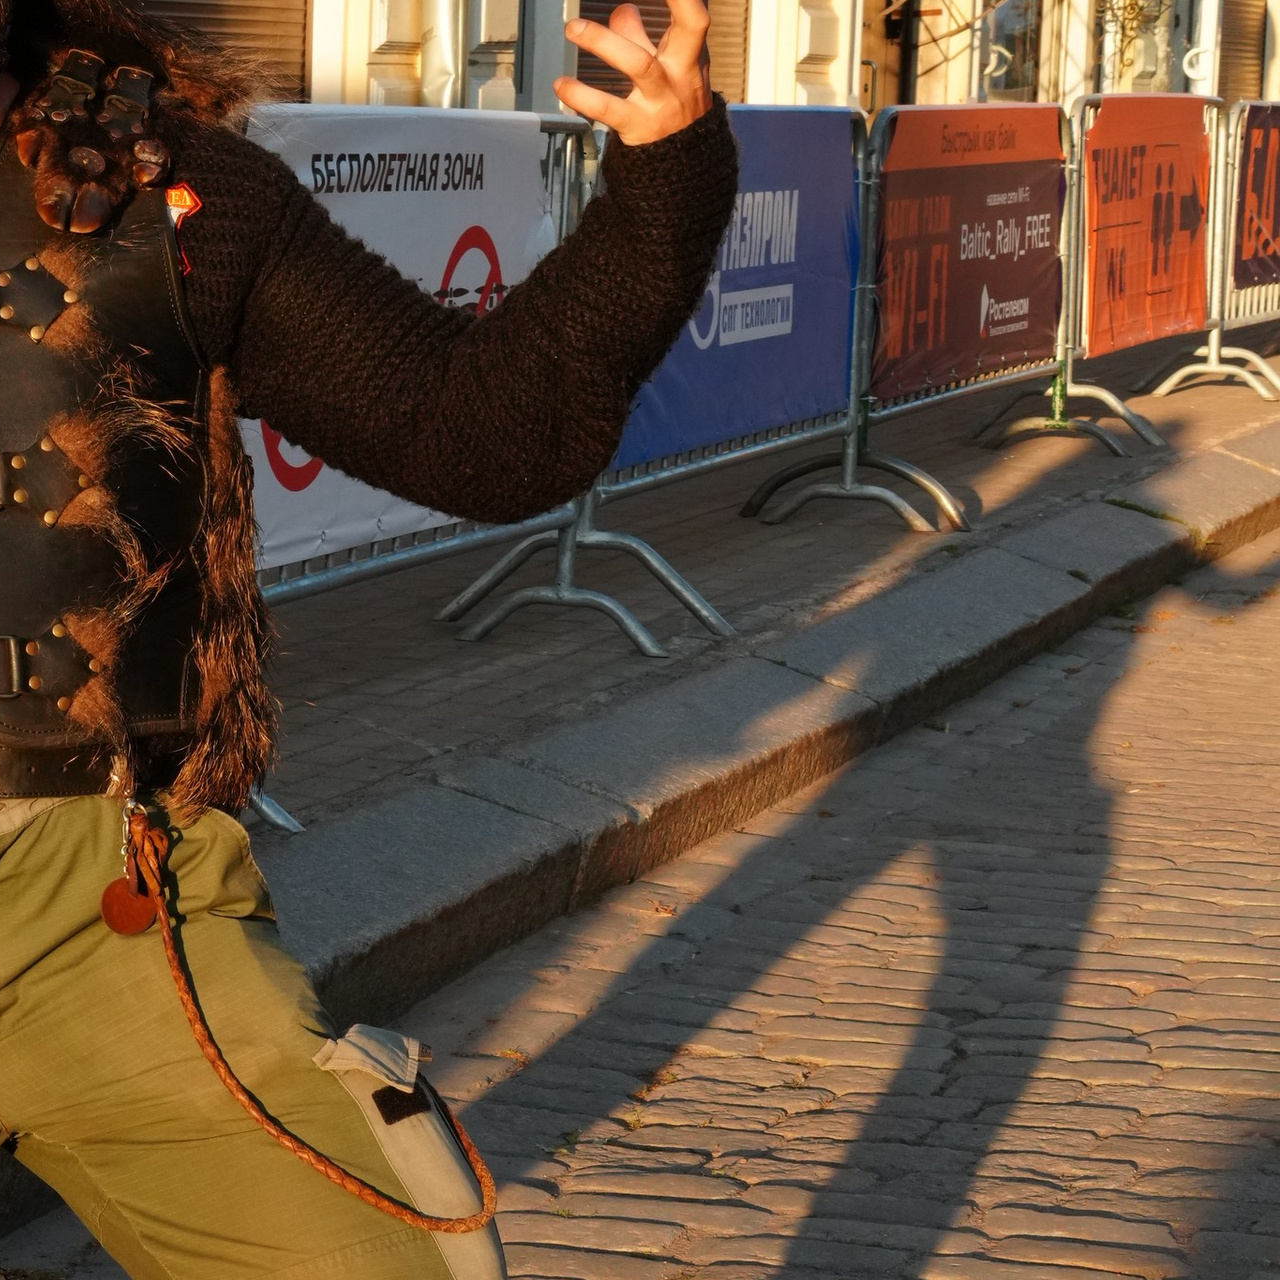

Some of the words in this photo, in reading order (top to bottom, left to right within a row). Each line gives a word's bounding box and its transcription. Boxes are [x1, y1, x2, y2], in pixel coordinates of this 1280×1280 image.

[311, 153, 440, 193] БЕСПОЛЕТНАЯ
[441, 153, 484, 191] ЗОНА
[1092, 144, 1147, 204] ТУАЛЕТ
[960, 213, 1051, 261] Baltic_Rally_FREE
[722, 304, 738, 333] СПГ
[741, 295, 791, 330] ТЕХНОЛОГИИ
[989, 297, 1029, 322] Ростелеком
